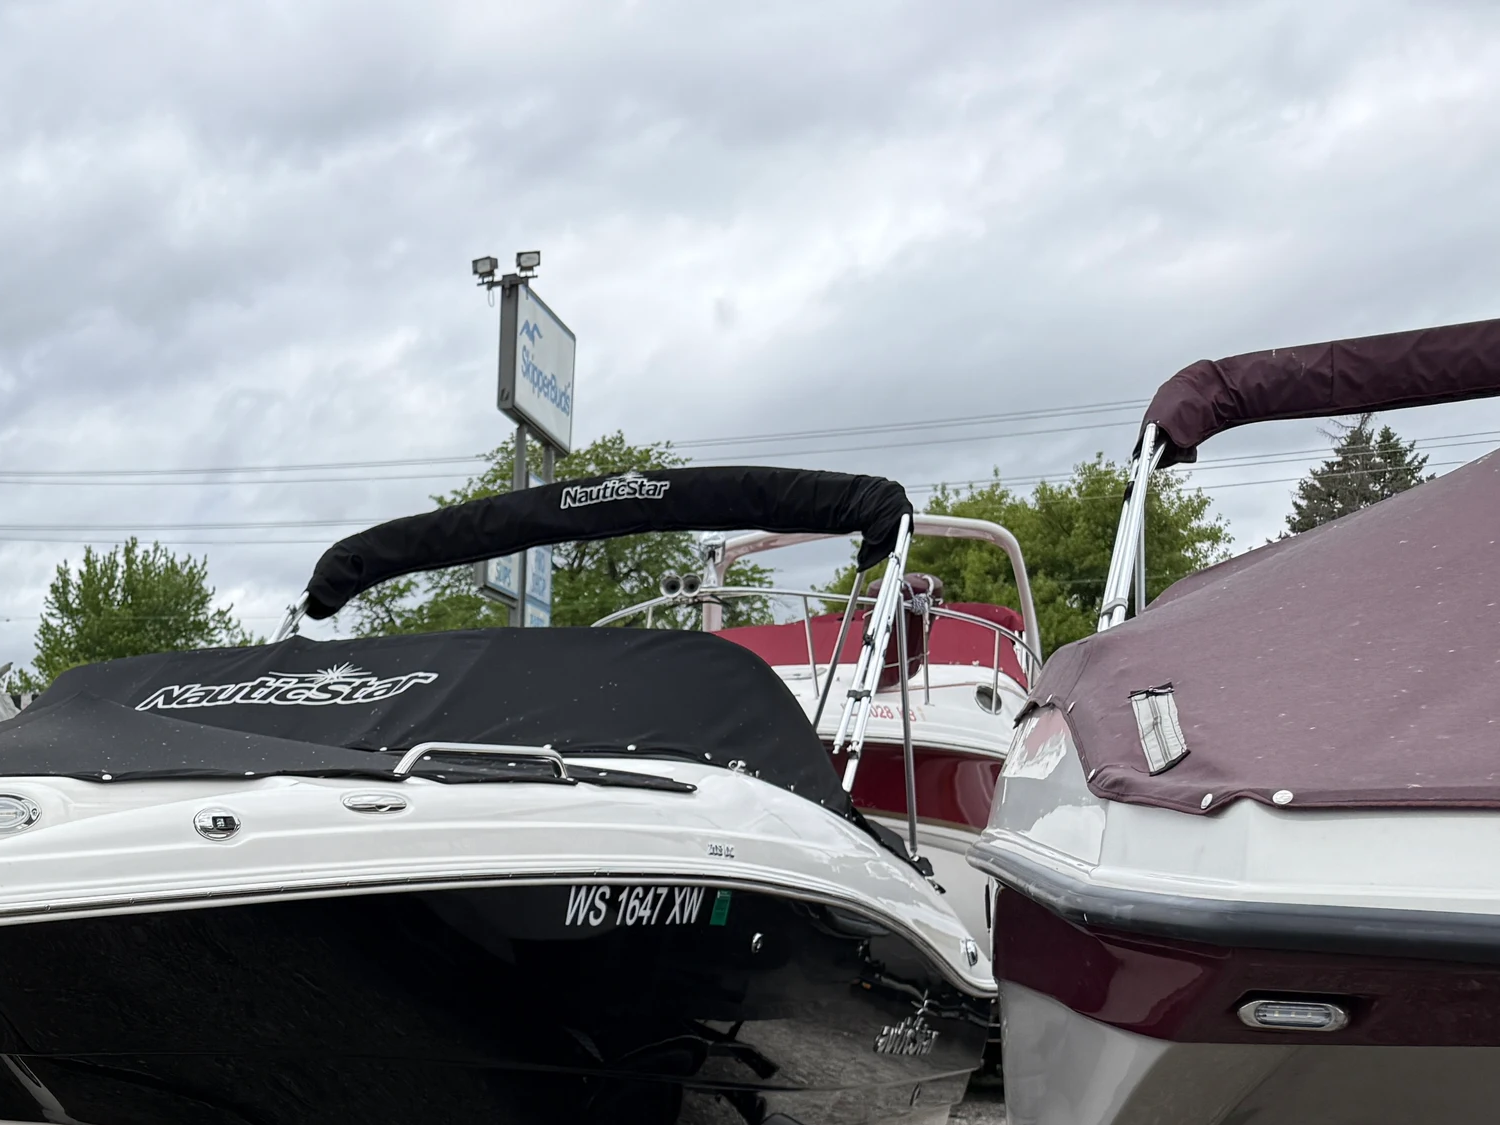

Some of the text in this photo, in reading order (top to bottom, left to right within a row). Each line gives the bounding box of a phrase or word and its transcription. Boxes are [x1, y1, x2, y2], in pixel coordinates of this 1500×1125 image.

[560, 478, 671, 509] NauticStar
[135, 672, 439, 711] NauticStar
[565, 885, 706, 927] WS 1647 XW
